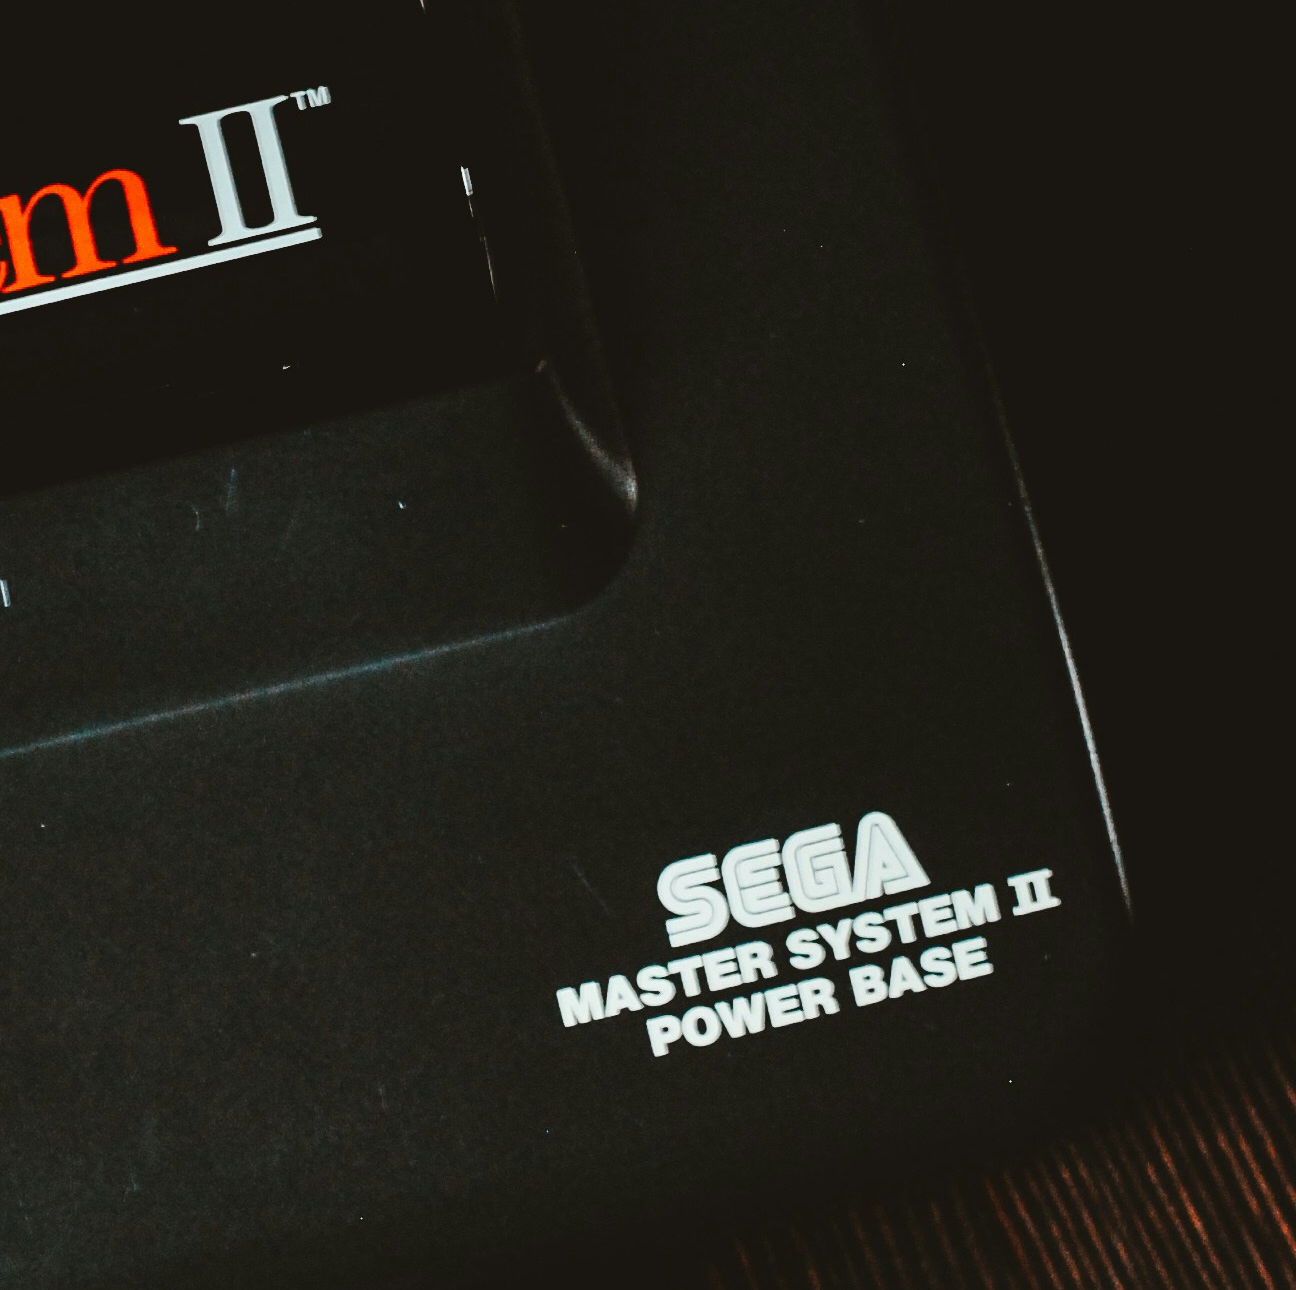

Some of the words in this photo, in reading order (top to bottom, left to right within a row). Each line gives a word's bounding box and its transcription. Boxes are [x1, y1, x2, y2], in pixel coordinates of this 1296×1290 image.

[178, 95, 318, 246] II
[556, 941, 779, 1028] MASTER
[786, 883, 1002, 971] SYSTEM
[1007, 868, 1062, 917] II
[656, 811, 931, 948] SEGA
[646, 978, 841, 1058] POWER
[849, 936, 994, 1008] BASE
